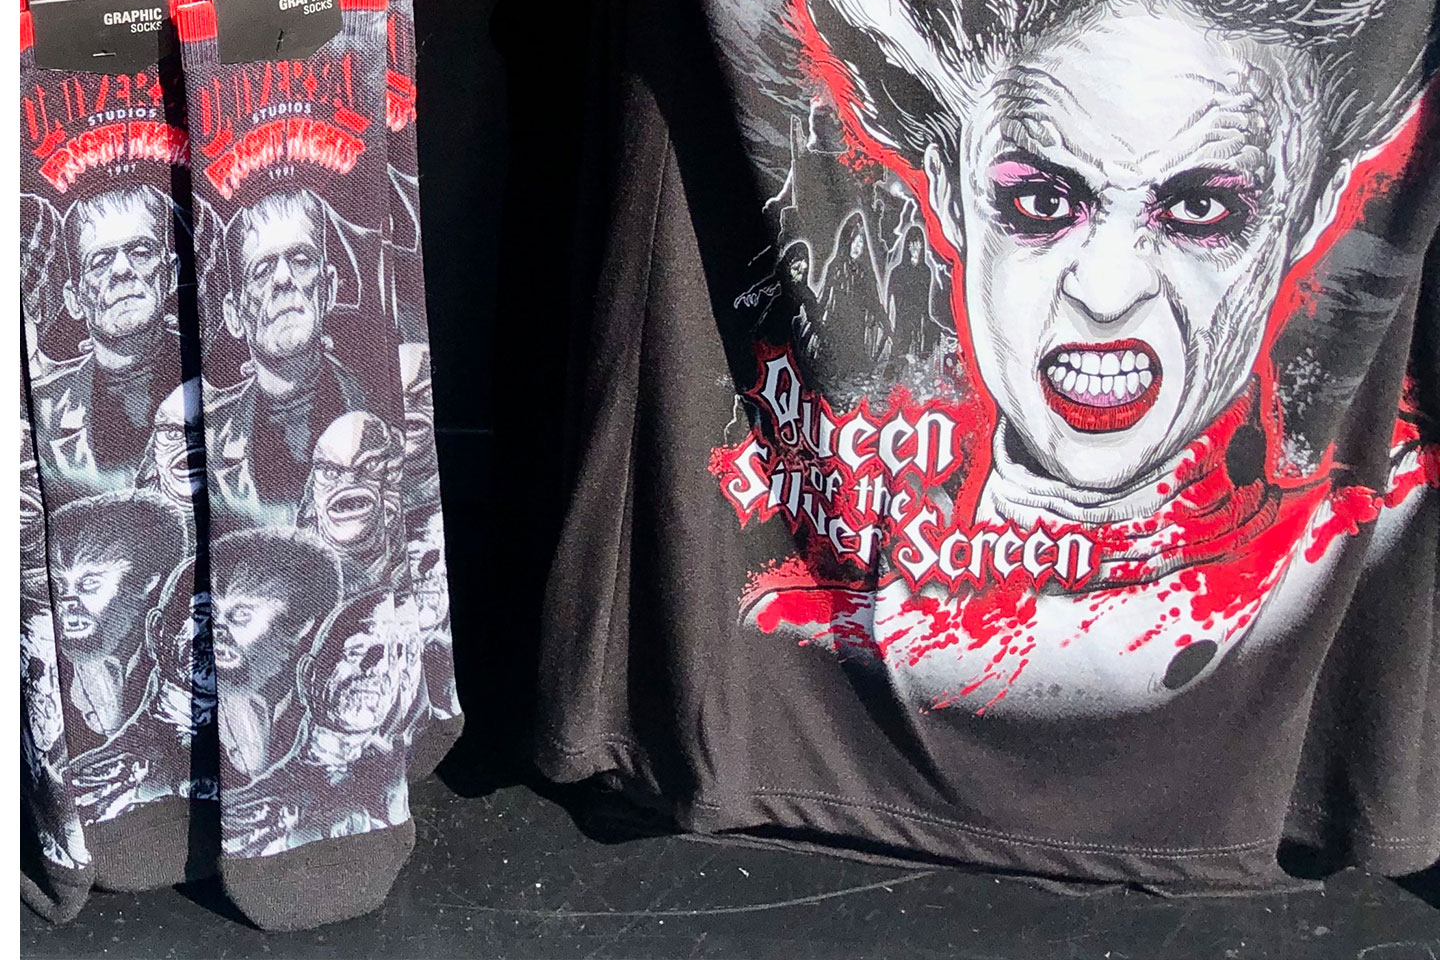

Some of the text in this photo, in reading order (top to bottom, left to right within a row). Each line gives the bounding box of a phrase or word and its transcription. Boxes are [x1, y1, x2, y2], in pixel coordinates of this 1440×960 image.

[103, 8, 163, 25] GRAPHIC
[303, 0, 333, 15] SOCKS
[130, 21, 162, 33] SOCKS
[88, 107, 157, 126] STUDIOS
[251, 103, 311, 125] STUDIOS
[269, 165, 295, 180] 1991
[760, 354, 956, 480] Queen
[855, 474, 911, 523] the
[727, 438, 1096, 583] Silver Screen
